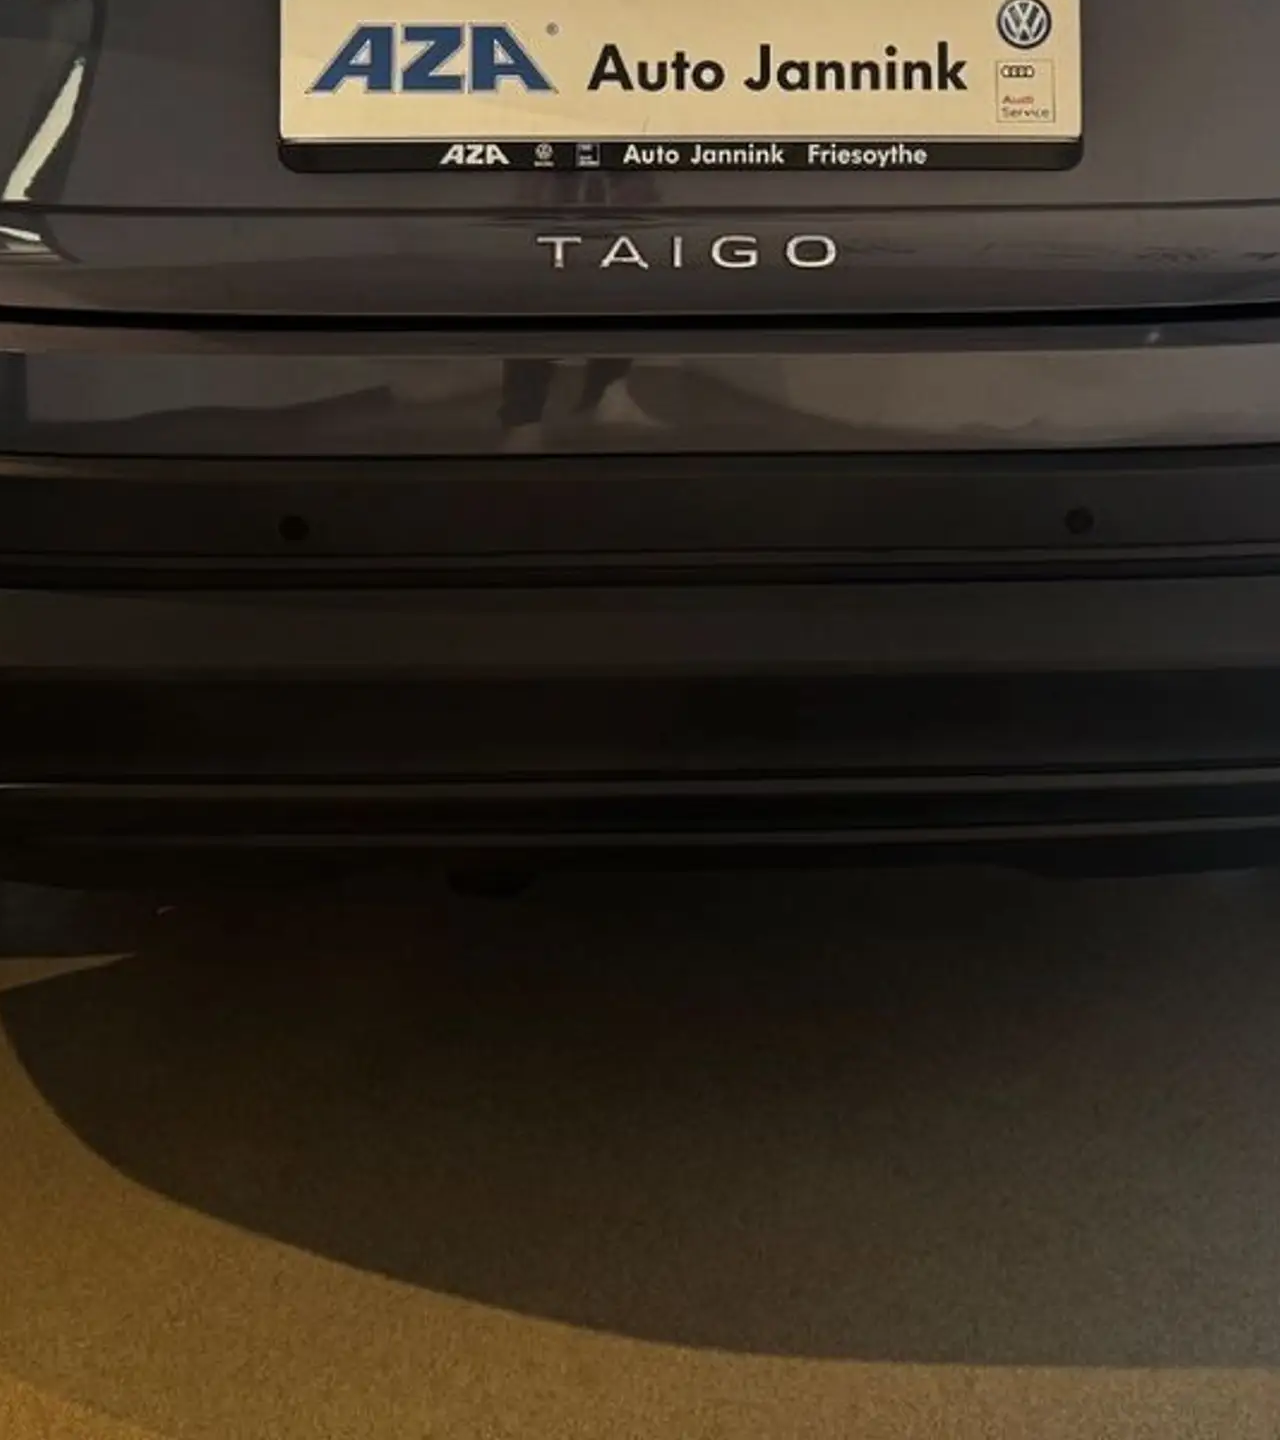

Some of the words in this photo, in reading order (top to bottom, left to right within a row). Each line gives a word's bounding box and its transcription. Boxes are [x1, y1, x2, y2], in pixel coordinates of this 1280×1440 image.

[305, 22, 559, 94] AZA
[587, 43, 725, 91] Auto
[743, 41, 968, 91] Jannink
[440, 143, 511, 165] AZA
[623, 144, 680, 164] Auto
[690, 144, 785, 164] Jannink
[808, 144, 928, 168] Friesoythe
[537, 235, 837, 269] TAIGO
